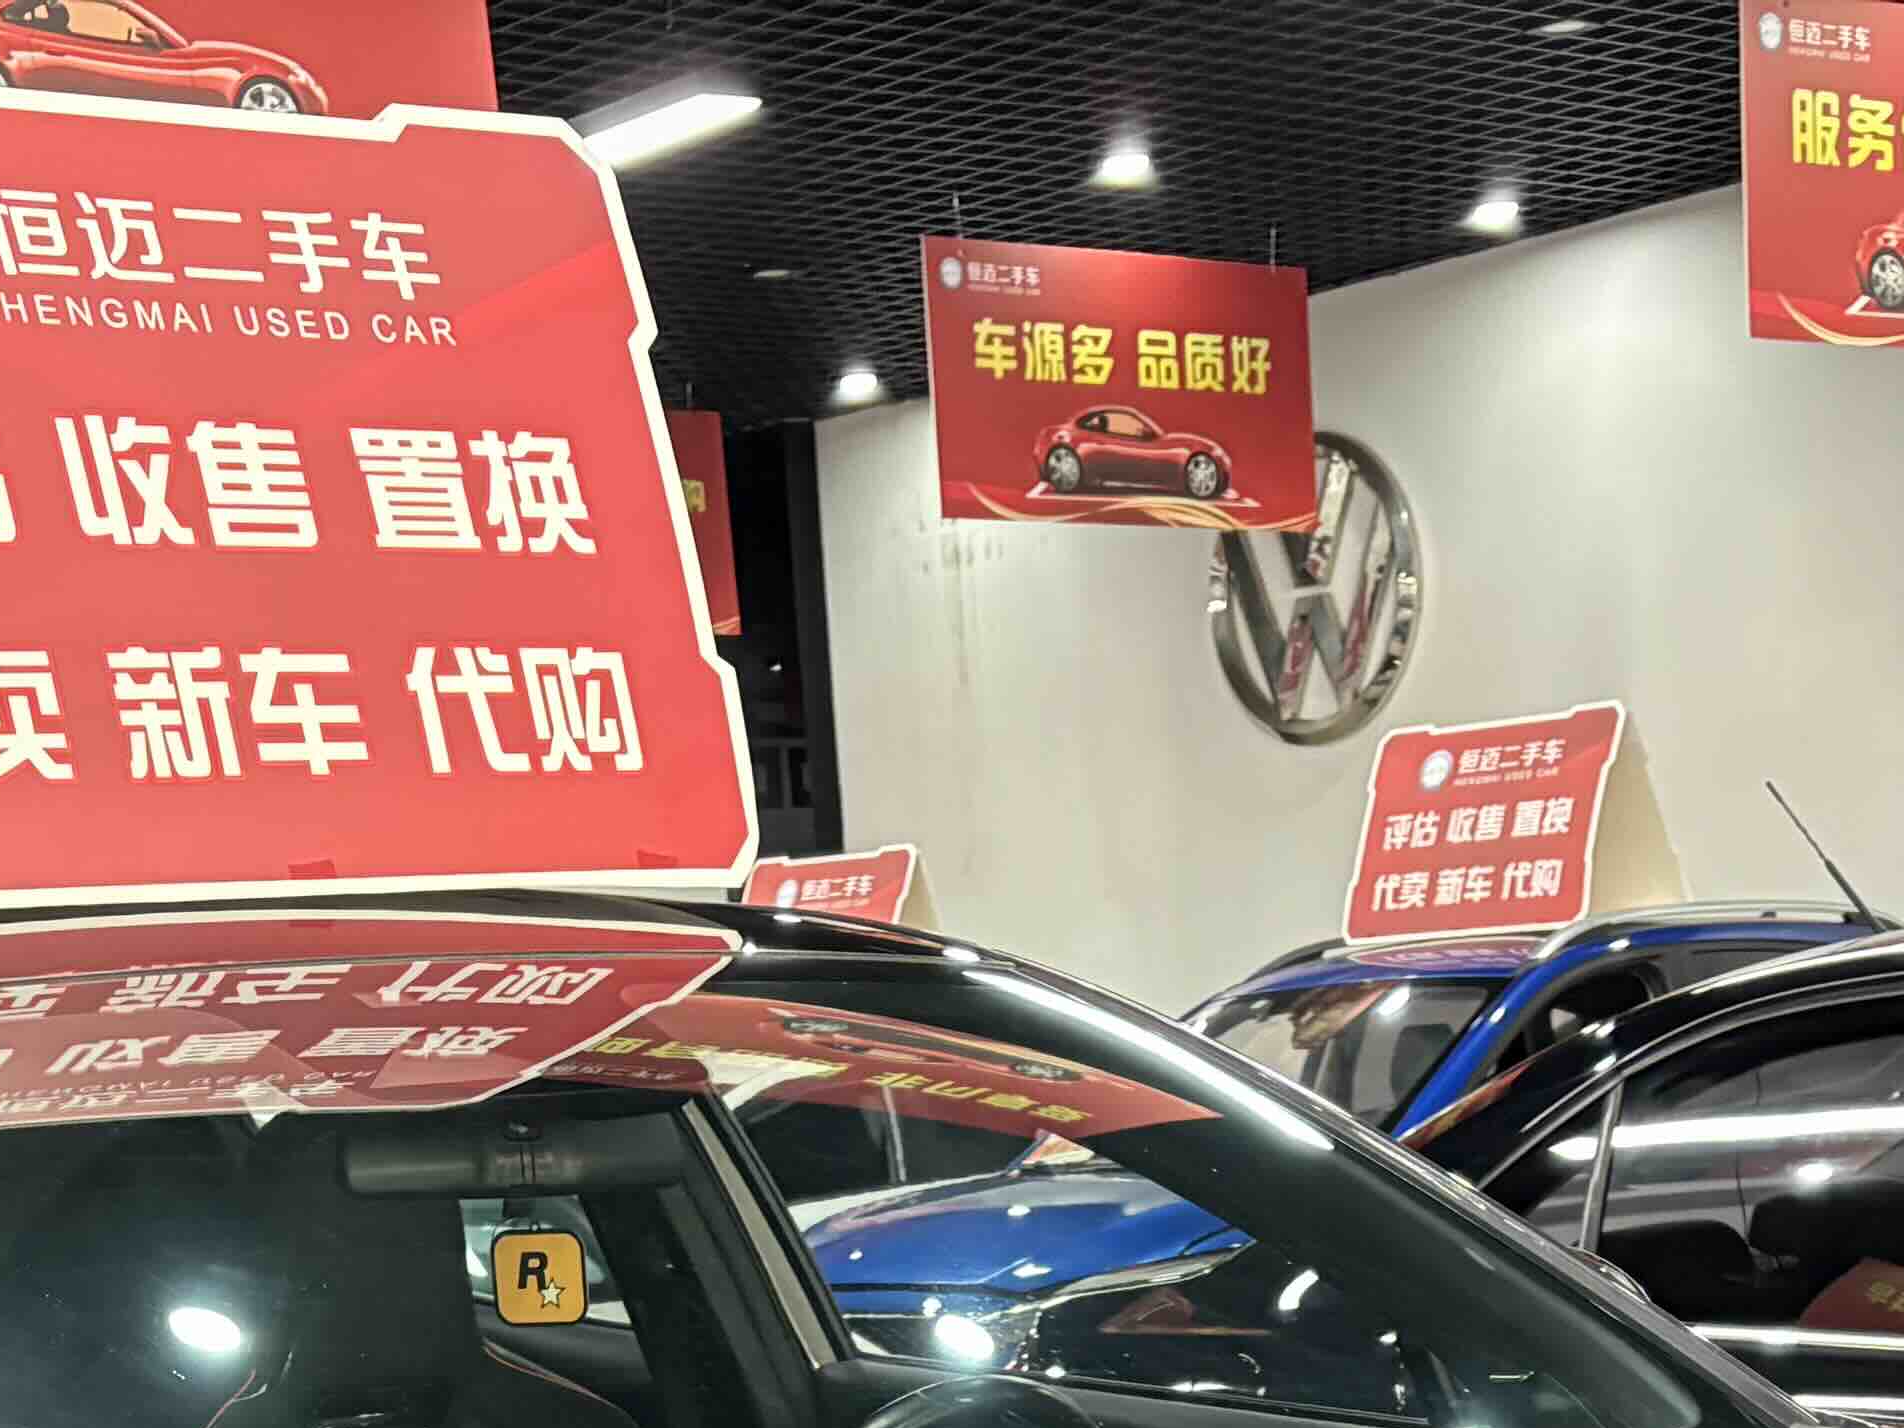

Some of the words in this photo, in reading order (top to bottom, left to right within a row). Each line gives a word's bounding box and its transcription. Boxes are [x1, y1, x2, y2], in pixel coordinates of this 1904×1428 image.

[1788, 18, 1872, 51] 恒迈二手车
[0, 292, 214, 334] HENGMAI
[232, 304, 351, 341] USED
[371, 313, 457, 345] CAR
[973, 317, 1115, 385] 车源多
[1137, 329, 1271, 395] 品质好
[53, 413, 320, 550] 收售
[348, 426, 599, 554] 置换
[106, 645, 370, 779] 新车
[405, 644, 646, 775] 代购
[1383, 811, 1440, 852] 评估
[1446, 804, 1506, 844] 收售
[1372, 871, 1430, 912] 代卖
[1434, 865, 1496, 907] 新车
[1501, 859, 1564, 900] 代购
[517, 1251, 548, 1294] R
